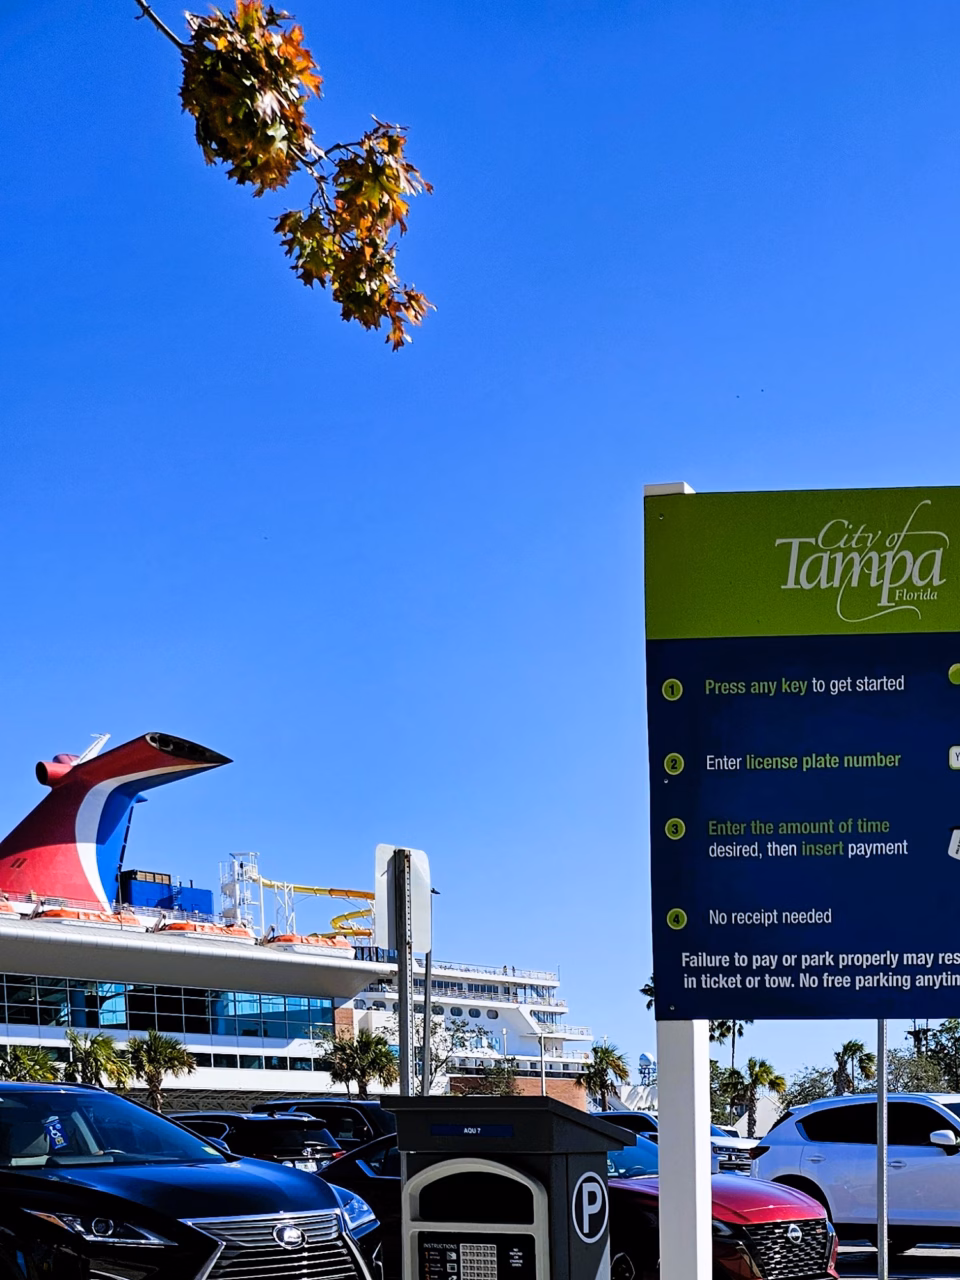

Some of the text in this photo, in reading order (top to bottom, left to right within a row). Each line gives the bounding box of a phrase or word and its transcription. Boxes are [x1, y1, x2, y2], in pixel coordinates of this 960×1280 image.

[775, 536, 947, 606] Tampa
[895, 588, 937, 600] Florida
[668, 675, 904, 696] 1 Press any key to get started
[670, 752, 901, 771] 2 Enter license plate number
[671, 818, 889, 835] 3 Enter the amount of time
[709, 840, 908, 859] desired, then insert payment
[672, 909, 831, 927] 4 No receipt needed
[682, 952, 729, 966] Failure
[734, 952, 747, 966] to
[753, 955, 778, 969] pay
[783, 955, 797, 966] or
[802, 951, 834, 969] park
[839, 951, 898, 968] properly
[904, 953, 934, 967] may
[684, 974, 696, 988] in
[701, 974, 742, 988] ticket
[746, 977, 760, 988] or
[765, 974, 794, 987] tow.
[800, 973, 818, 987] No
[823, 973, 851, 987] free
[856, 972, 910, 990] parking
[582, 1182, 602, 1233] P
